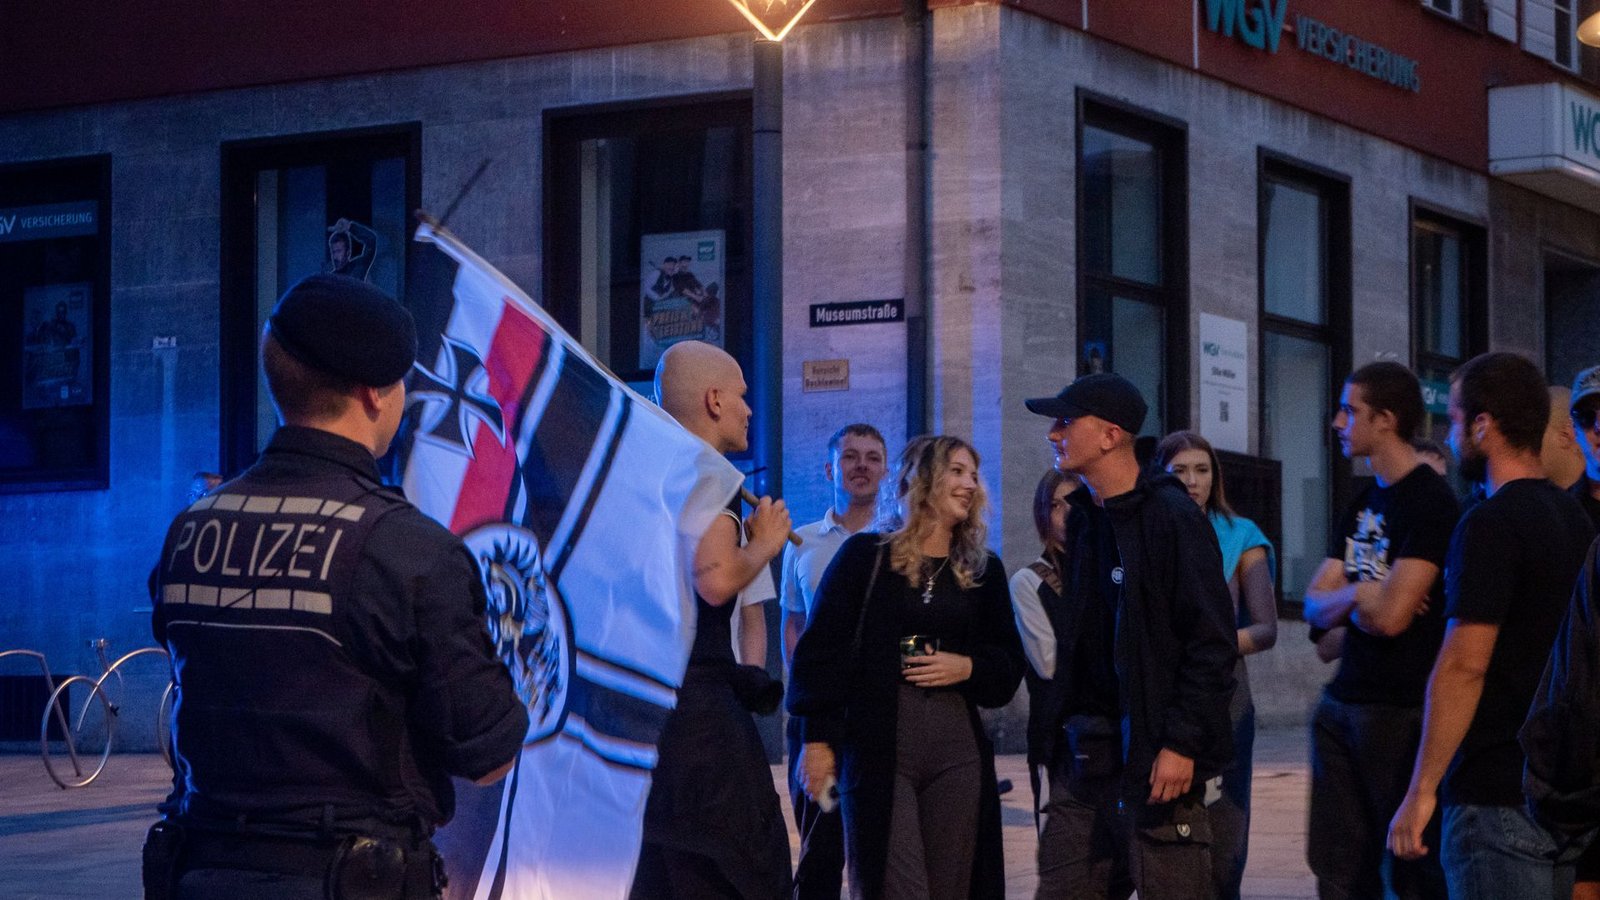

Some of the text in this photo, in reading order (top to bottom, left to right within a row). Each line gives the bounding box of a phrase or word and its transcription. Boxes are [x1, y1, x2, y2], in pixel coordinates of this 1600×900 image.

[1204, 0, 1420, 93] WGV VERSICHERUNG
[21, 211, 93, 229] VERSICHERUNG
[816, 303, 898, 323] Museumstraße
[169, 519, 343, 581] POLIZEI
